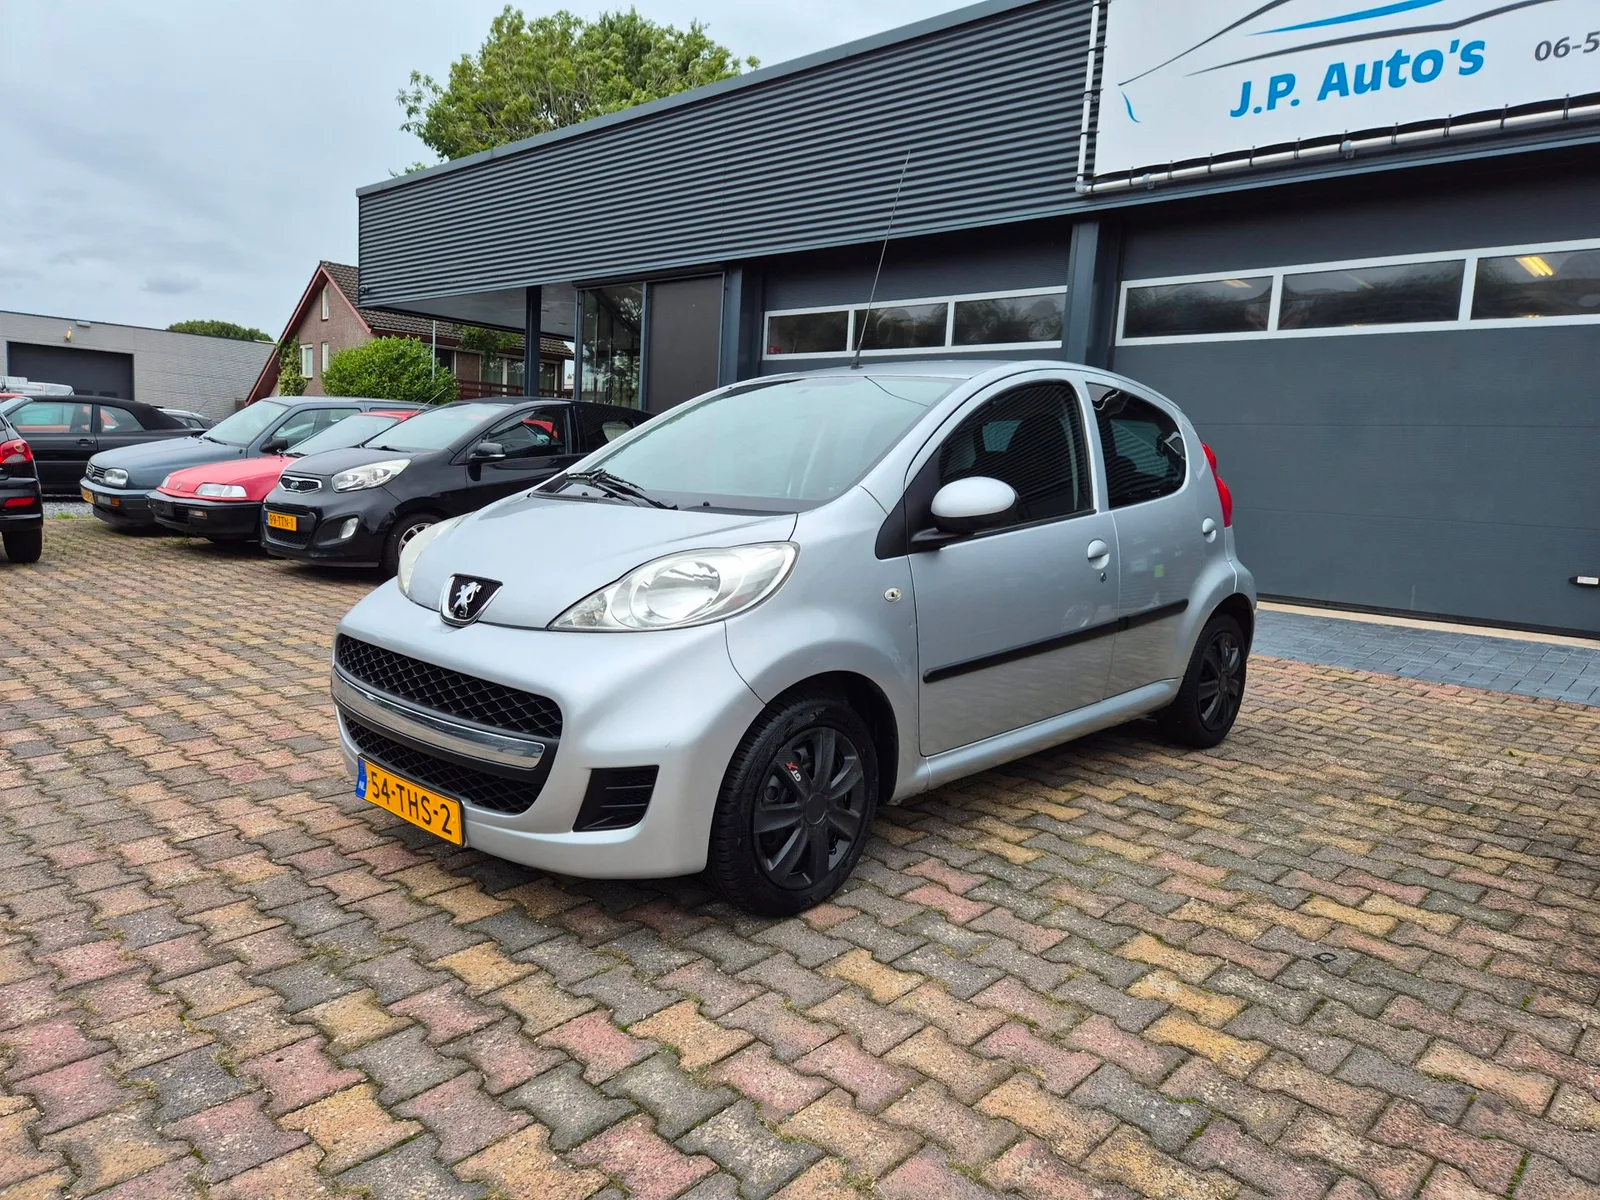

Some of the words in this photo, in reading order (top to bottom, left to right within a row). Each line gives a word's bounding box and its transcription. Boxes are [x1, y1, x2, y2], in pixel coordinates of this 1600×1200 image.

[1228, 72, 1302, 119] J.P.
[1316, 38, 1489, 103] Auto's
[1534, 30, 1600, 61] 06-5
[370, 770, 453, 836] 54-THS-2
